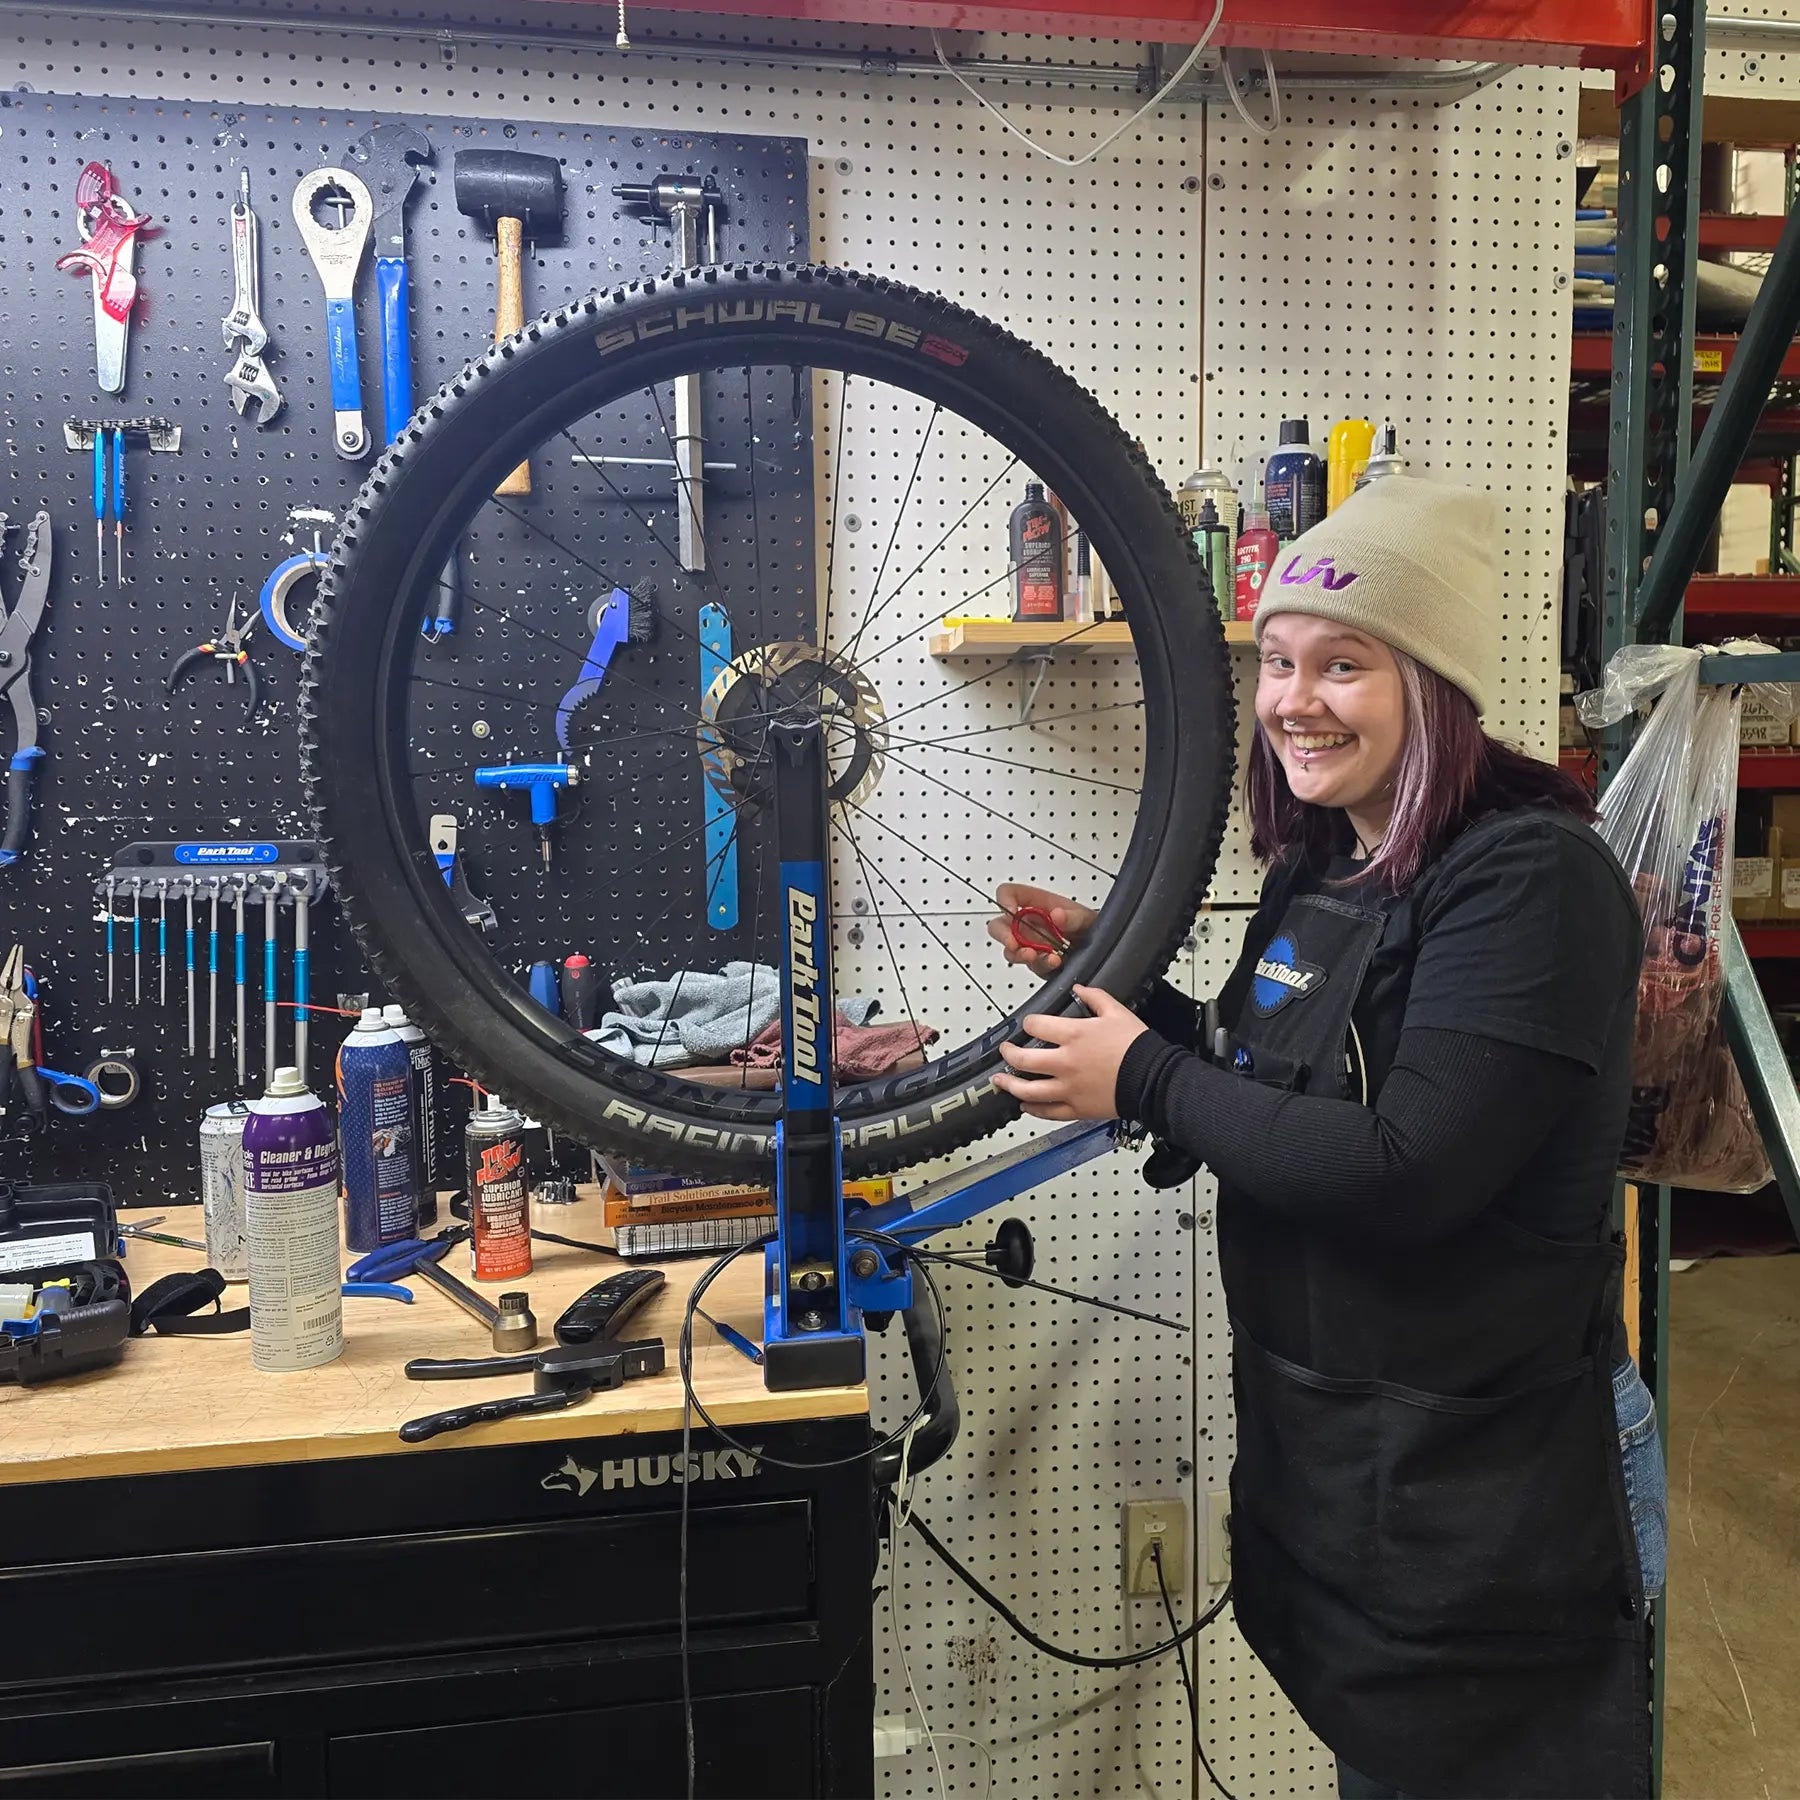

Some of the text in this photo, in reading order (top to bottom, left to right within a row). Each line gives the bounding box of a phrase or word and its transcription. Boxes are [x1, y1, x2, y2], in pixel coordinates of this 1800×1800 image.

[595, 301, 922, 356] SCHWALBE
[1237, 544, 1260, 556] LOCTITE
[1279, 555, 1360, 591] Liv
[1673, 817, 1723, 967] CINTAS
[1710, 903, 1722, 932] FOR
[788, 885, 823, 1086] ParkTool
[602, 1099, 776, 1156] RACIN
[260, 1150, 302, 1164] Cleaner
[304, 1146, 313, 1160] &
[476, 1143, 524, 1187] FLOW
[481, 1187, 523, 1203] LUBRICANT
[483, 1180, 521, 1194] SUPERIOR
[650, 1192, 672, 1206] Trail
[673, 1187, 720, 1203] Solutions
[660, 1205, 694, 1214] Bicycle
[696, 1200, 755, 1212] Maintenance
[602, 1446, 764, 1491] HUSKY
